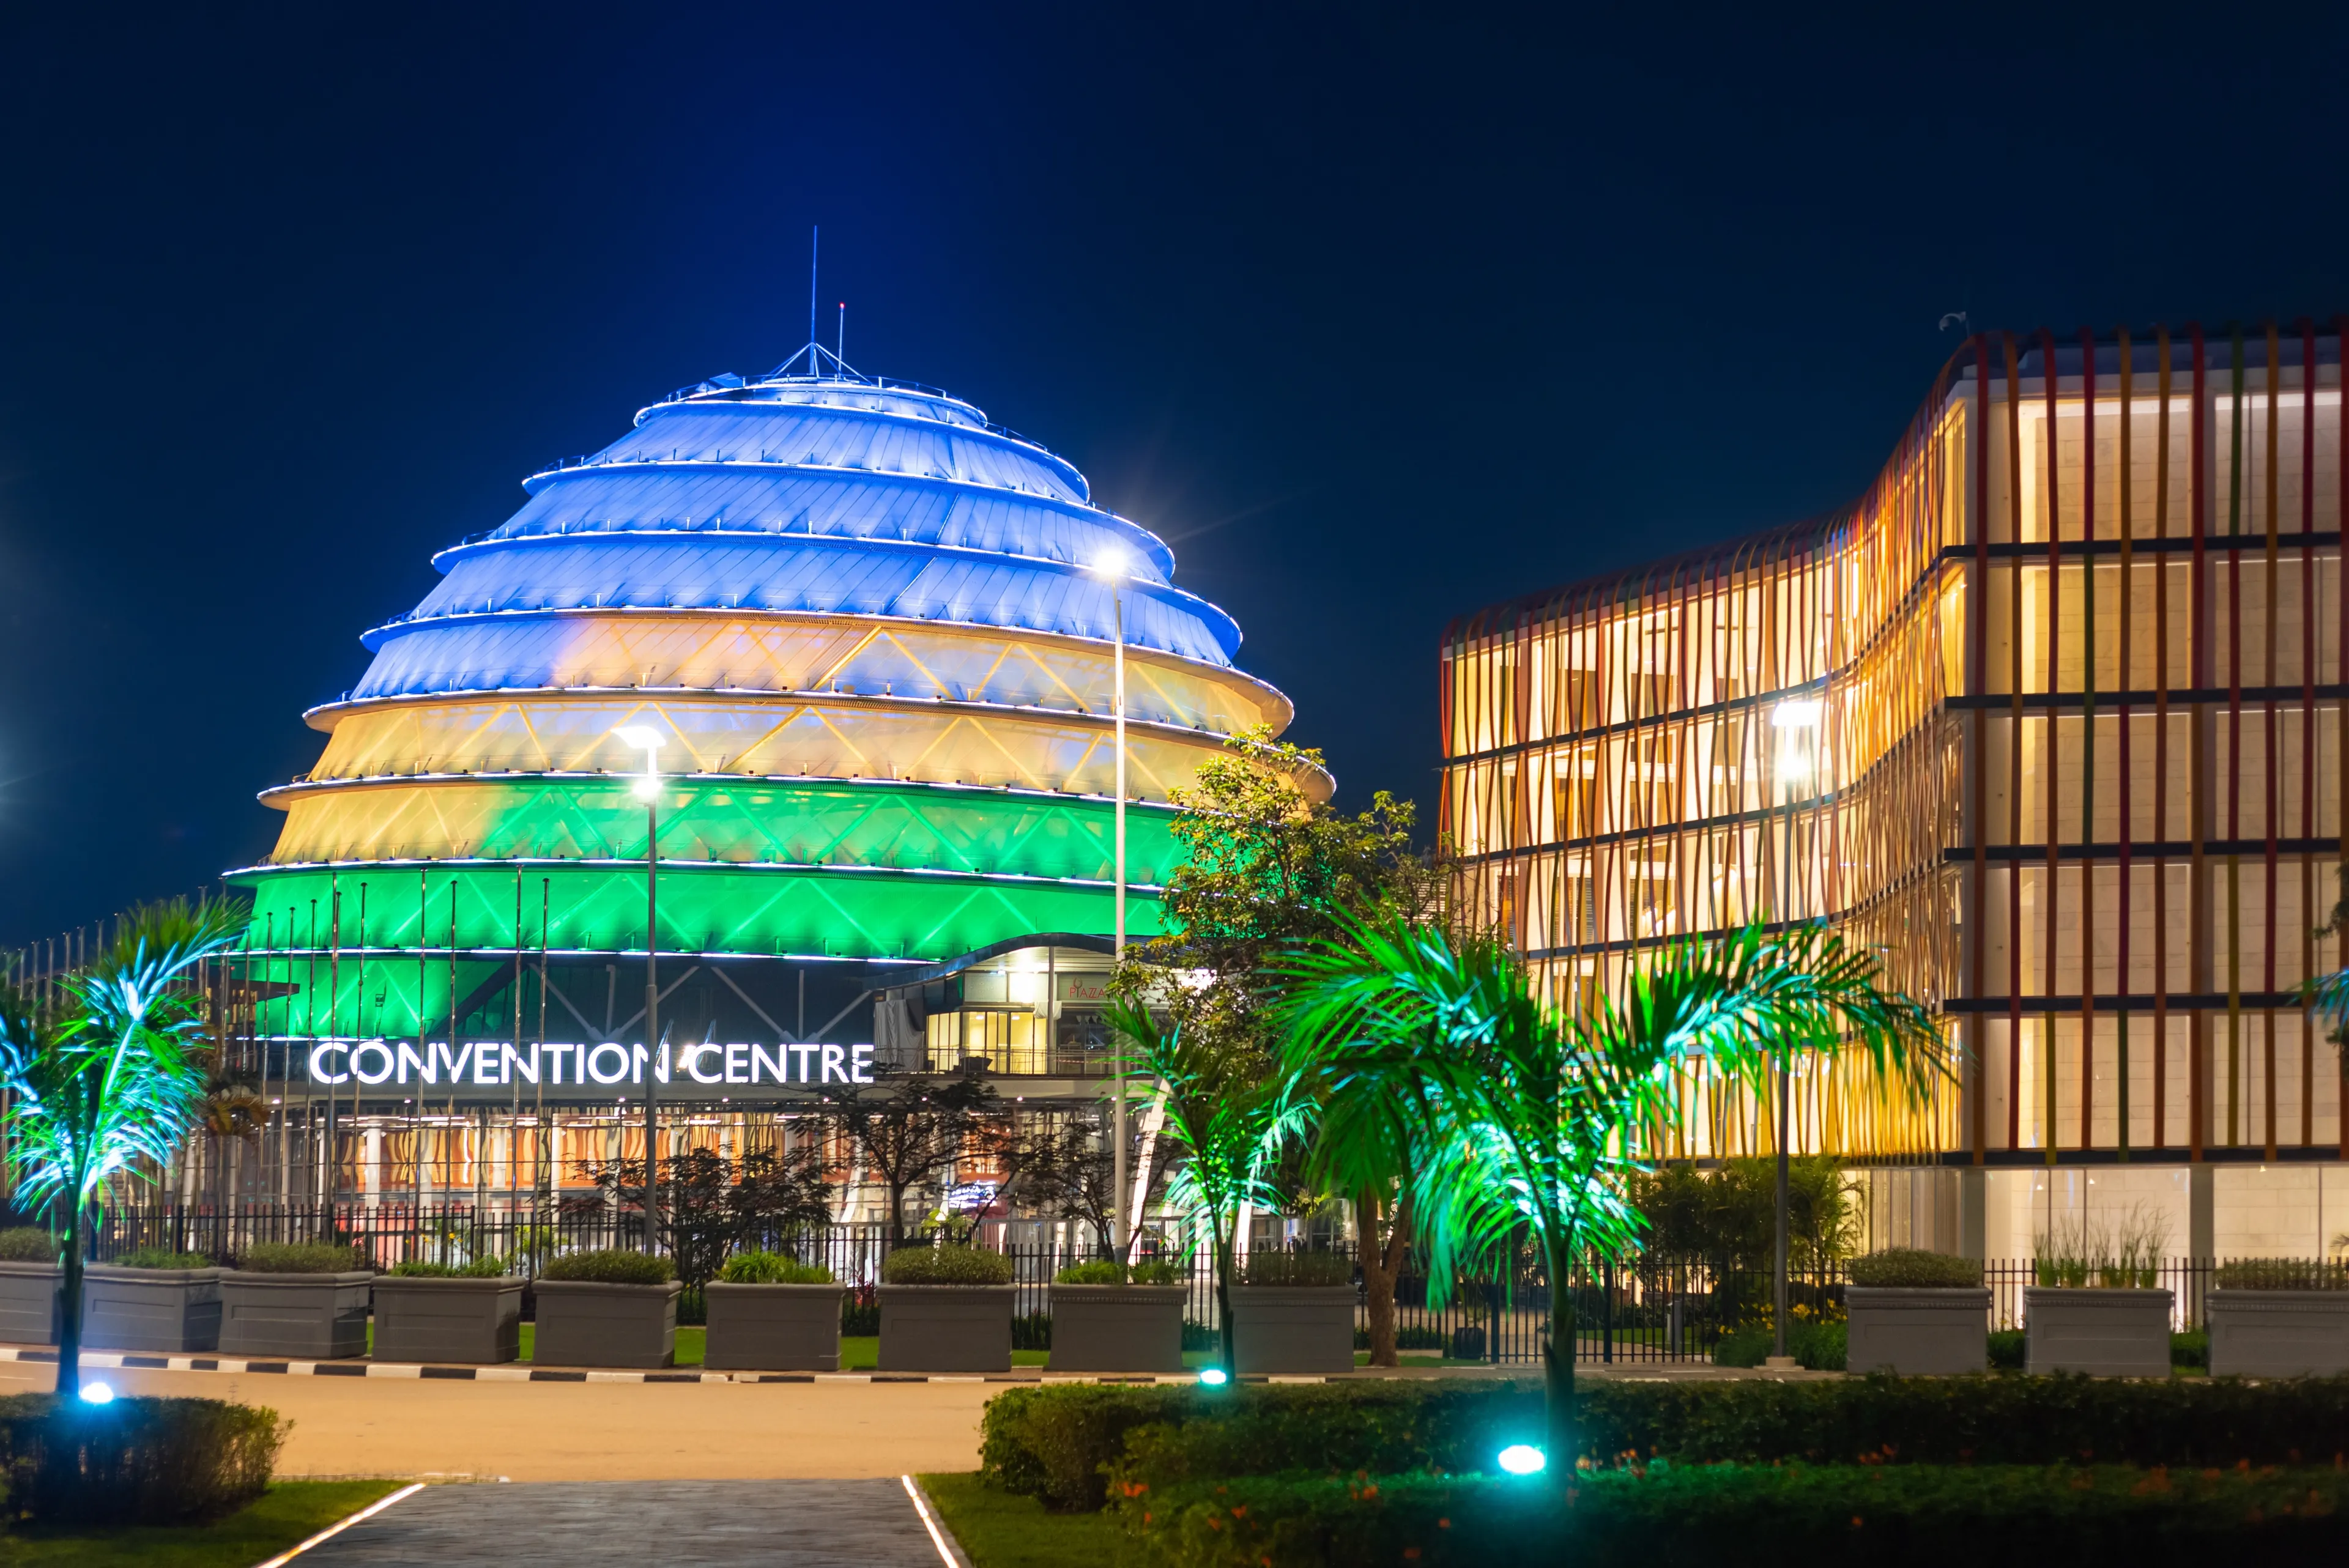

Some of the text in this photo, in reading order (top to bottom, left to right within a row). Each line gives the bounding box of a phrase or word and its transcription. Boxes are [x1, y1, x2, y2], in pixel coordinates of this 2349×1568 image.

[1069, 980, 1105, 999] PIAZZA
[309, 1041, 875, 1084] CONVENTION CENTRE
